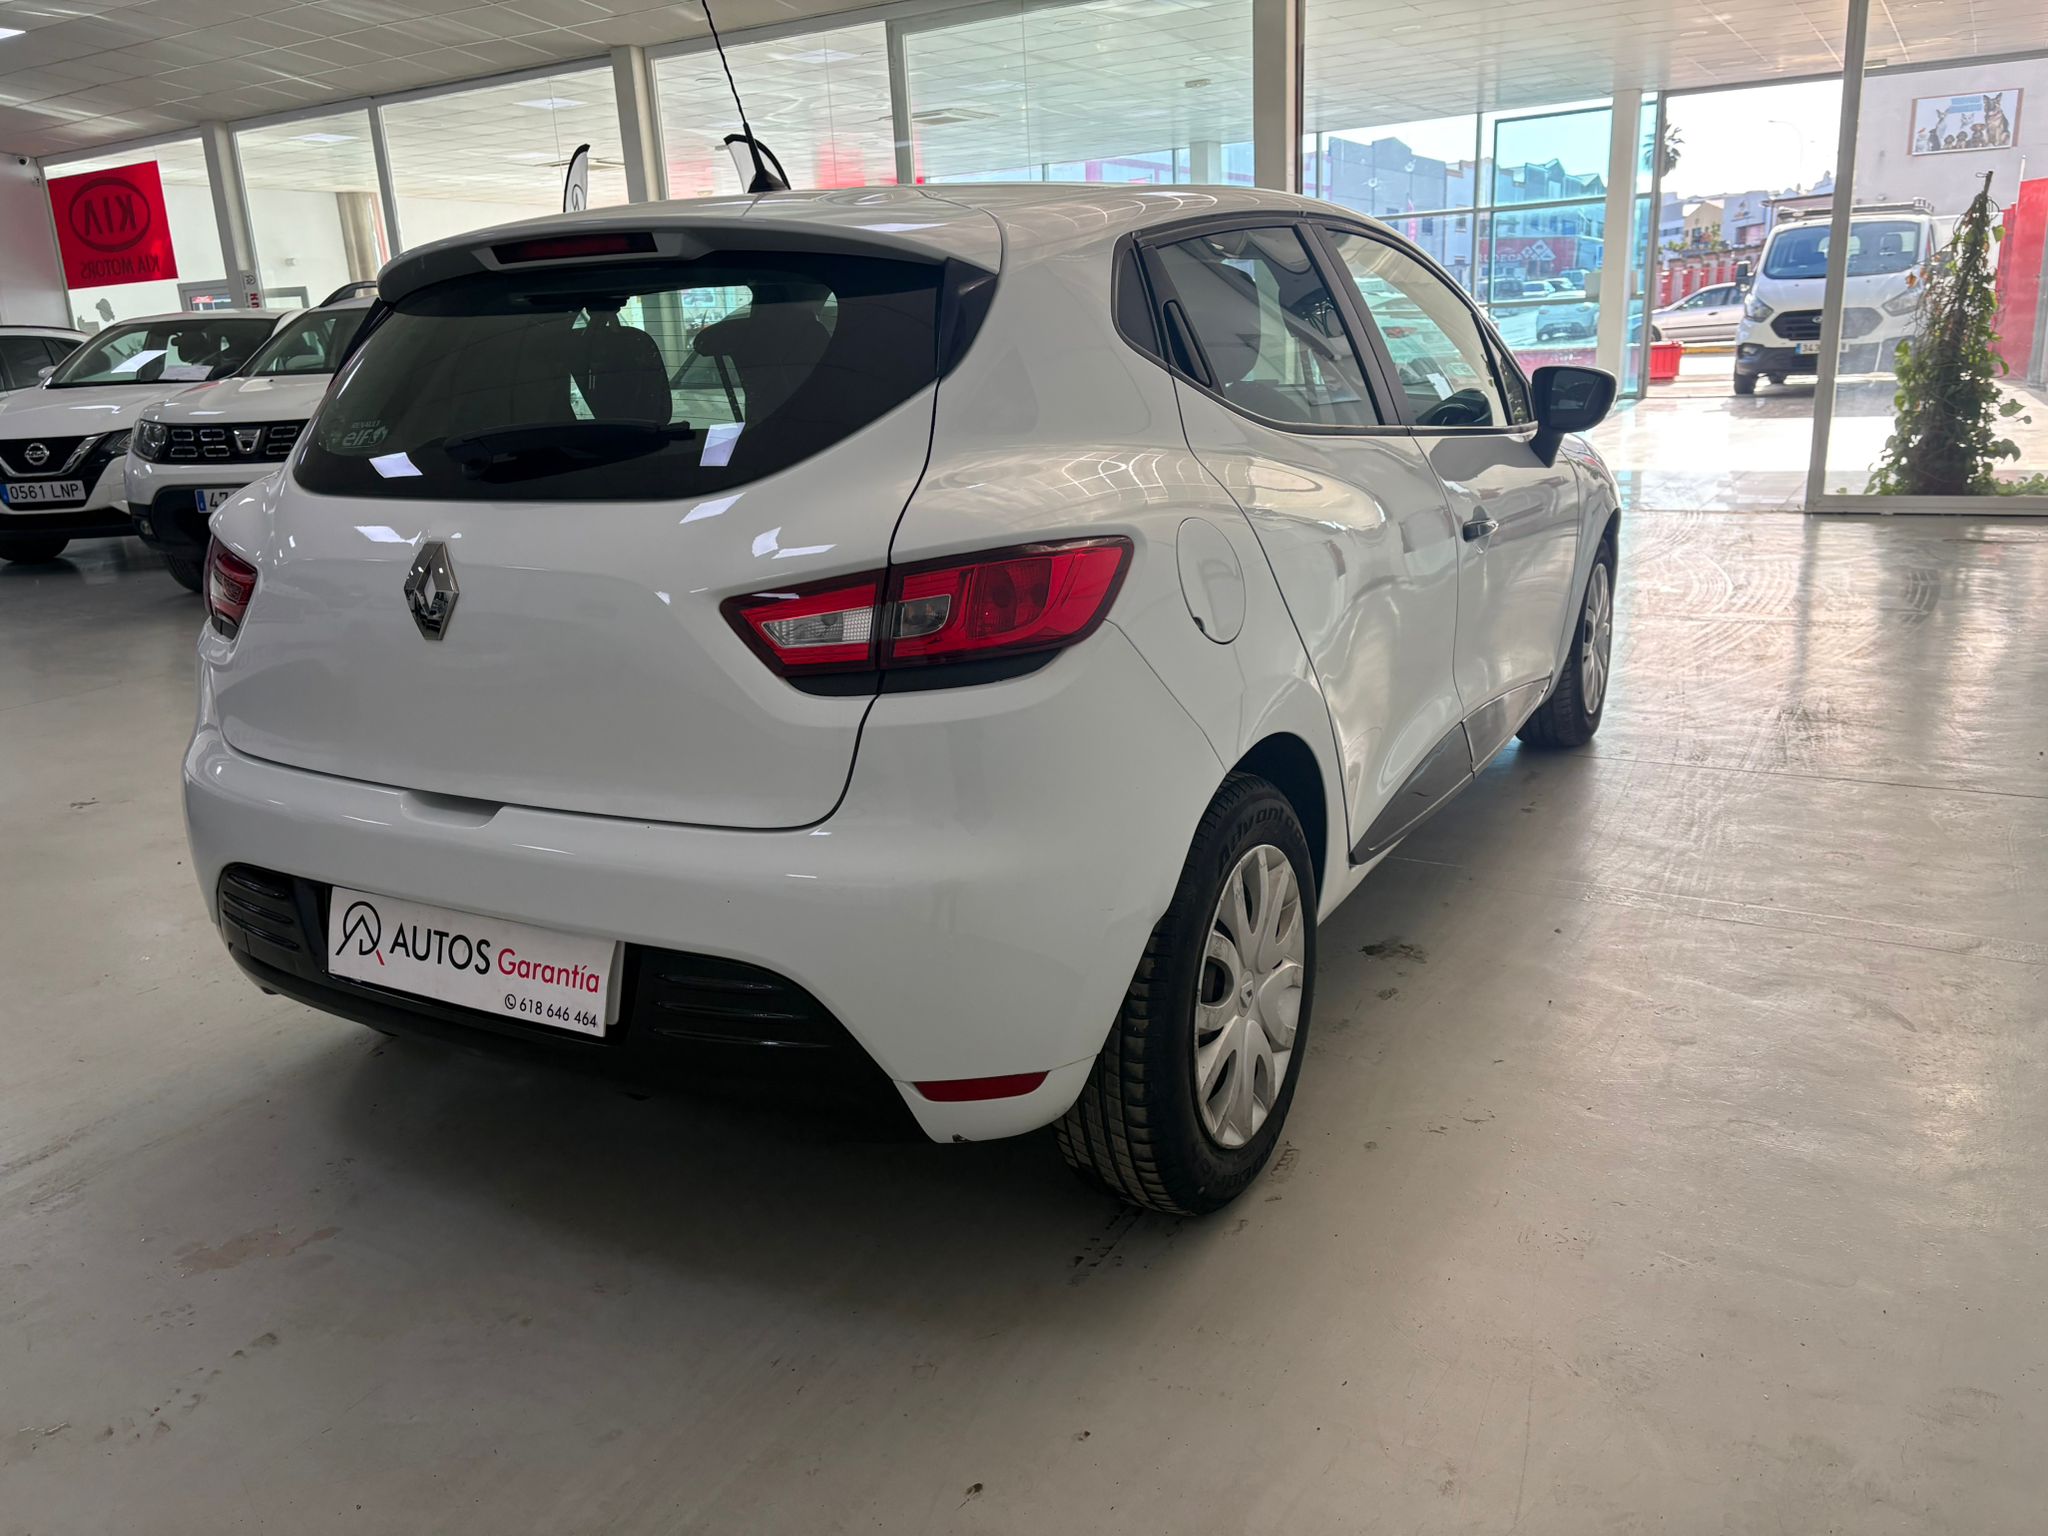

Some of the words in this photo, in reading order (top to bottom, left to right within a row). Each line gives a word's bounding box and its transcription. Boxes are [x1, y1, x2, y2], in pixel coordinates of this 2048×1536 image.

[10, 481, 46, 501] 0561
[50, 482, 79, 499] LNP
[389, 922, 491, 975] AUTOS
[498, 948, 600, 993] Garantía
[519, 997, 543, 1016] 618
[546, 1003, 570, 1022] 646
[574, 1011, 598, 1028] 464
